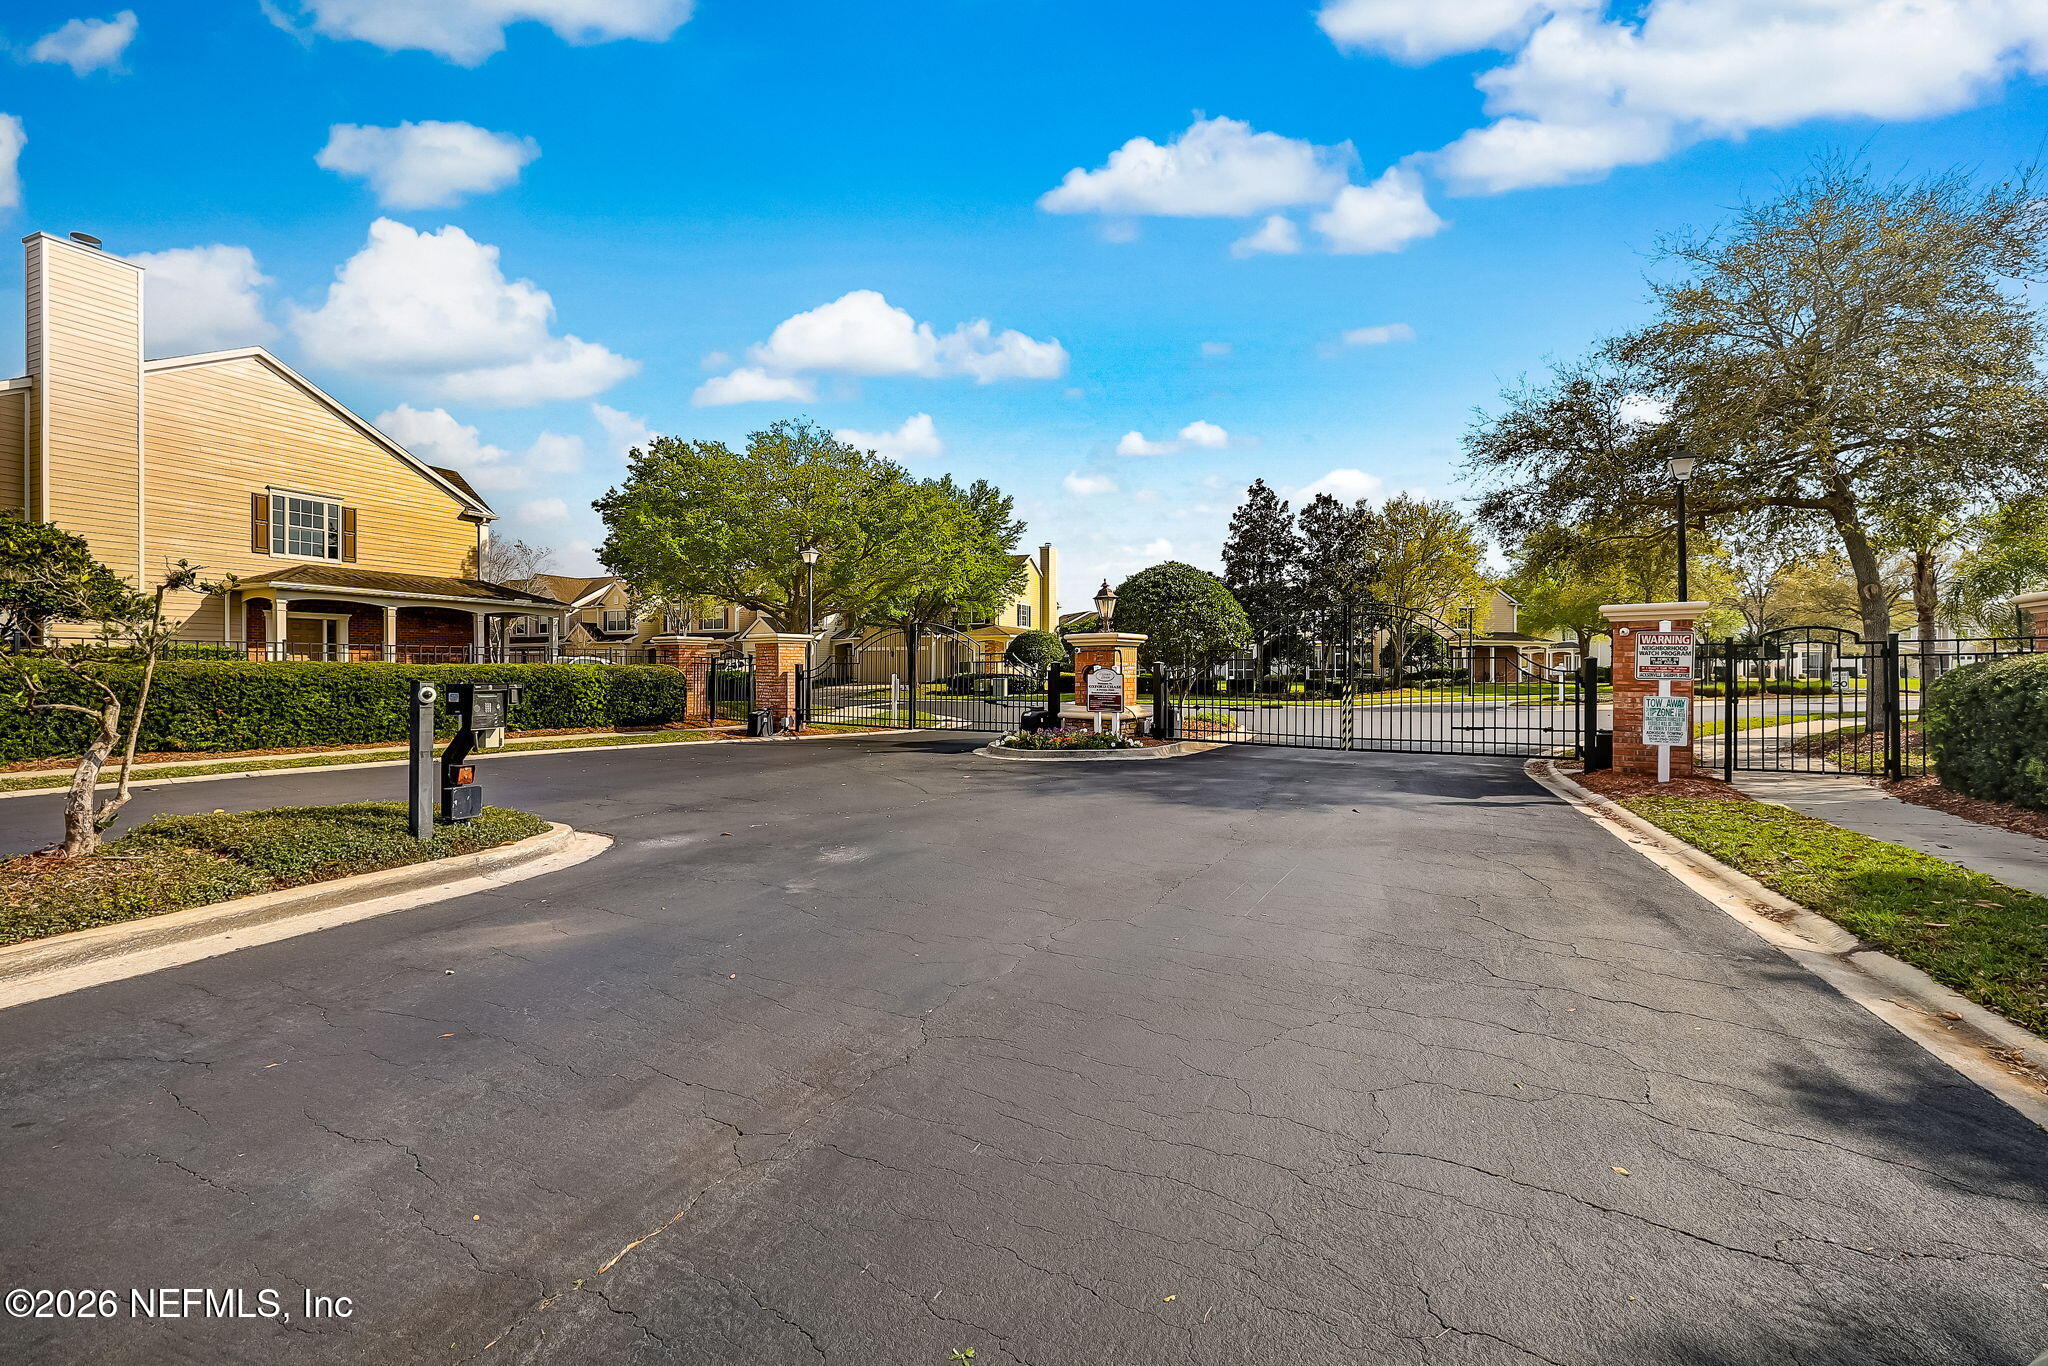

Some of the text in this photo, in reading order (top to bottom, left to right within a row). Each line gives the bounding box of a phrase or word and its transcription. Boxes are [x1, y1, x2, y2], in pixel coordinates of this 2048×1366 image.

[1641, 635, 1690, 644] WARNING
[1646, 699, 1685, 708] TOW AWAY
[1656, 708, 1674, 716] ZONE
